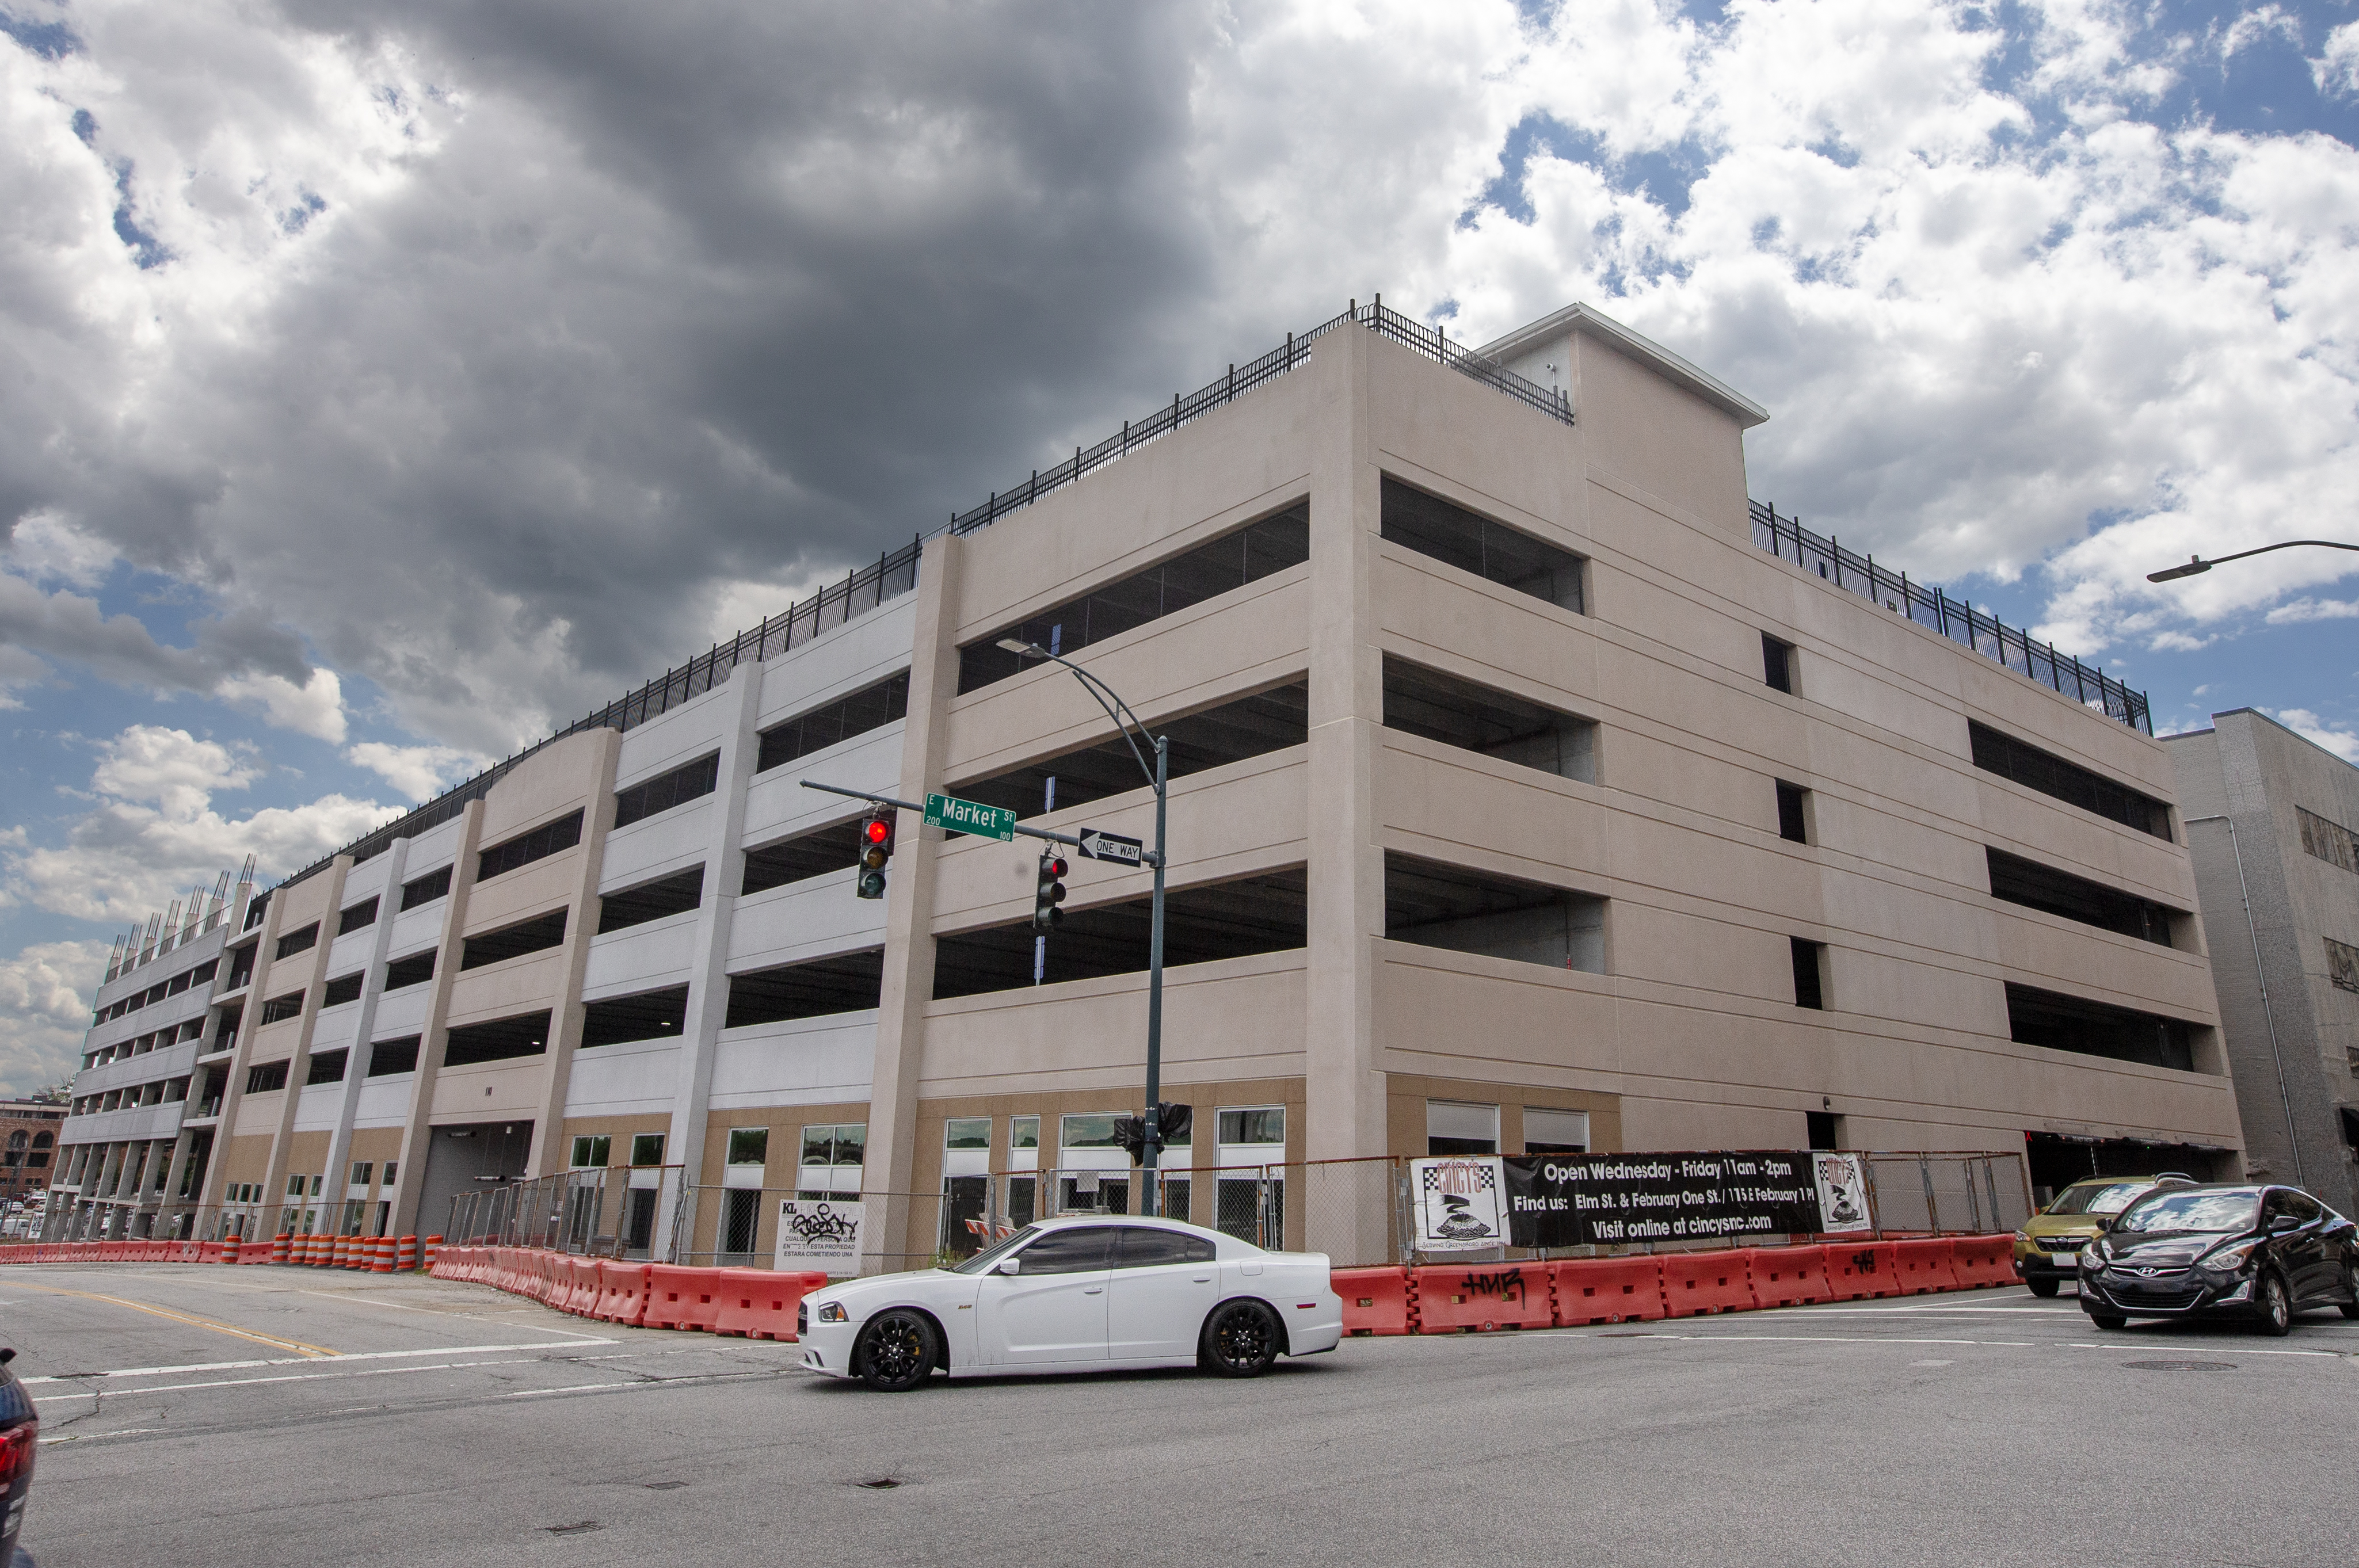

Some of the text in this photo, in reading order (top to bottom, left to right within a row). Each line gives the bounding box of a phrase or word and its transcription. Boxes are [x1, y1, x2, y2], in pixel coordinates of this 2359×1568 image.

[929, 795, 1013, 828] E Market St
[927, 815, 1011, 841] 200 100
[1097, 840, 1138, 858] ONE WAY
[1545, 1163, 1587, 1184] Open
[1590, 1162, 1671, 1181] Wednesday
[1682, 1161, 1721, 1179] Friday
[1724, 1159, 1756, 1174] 11am
[1765, 1159, 1792, 1178] 2pm
[783, 1203, 797, 1214] KL
[1514, 1196, 1546, 1211] Find
[1550, 1198, 1568, 1210] us:
[1575, 1195, 1599, 1208] Elm
[1601, 1193, 1616, 1208] St.
[1619, 1193, 1629, 1207] &
[1632, 1192, 1679, 1208] February
[1682, 1191, 1704, 1204] One
[1729, 1188, 1747, 1201] 115
[1748, 1188, 1754, 1201] E
[1755, 1188, 1797, 1203] February
[1799, 1188, 1805, 1201] 1
[1592, 1216, 1771, 1238] Visit online at cincysnc.com
